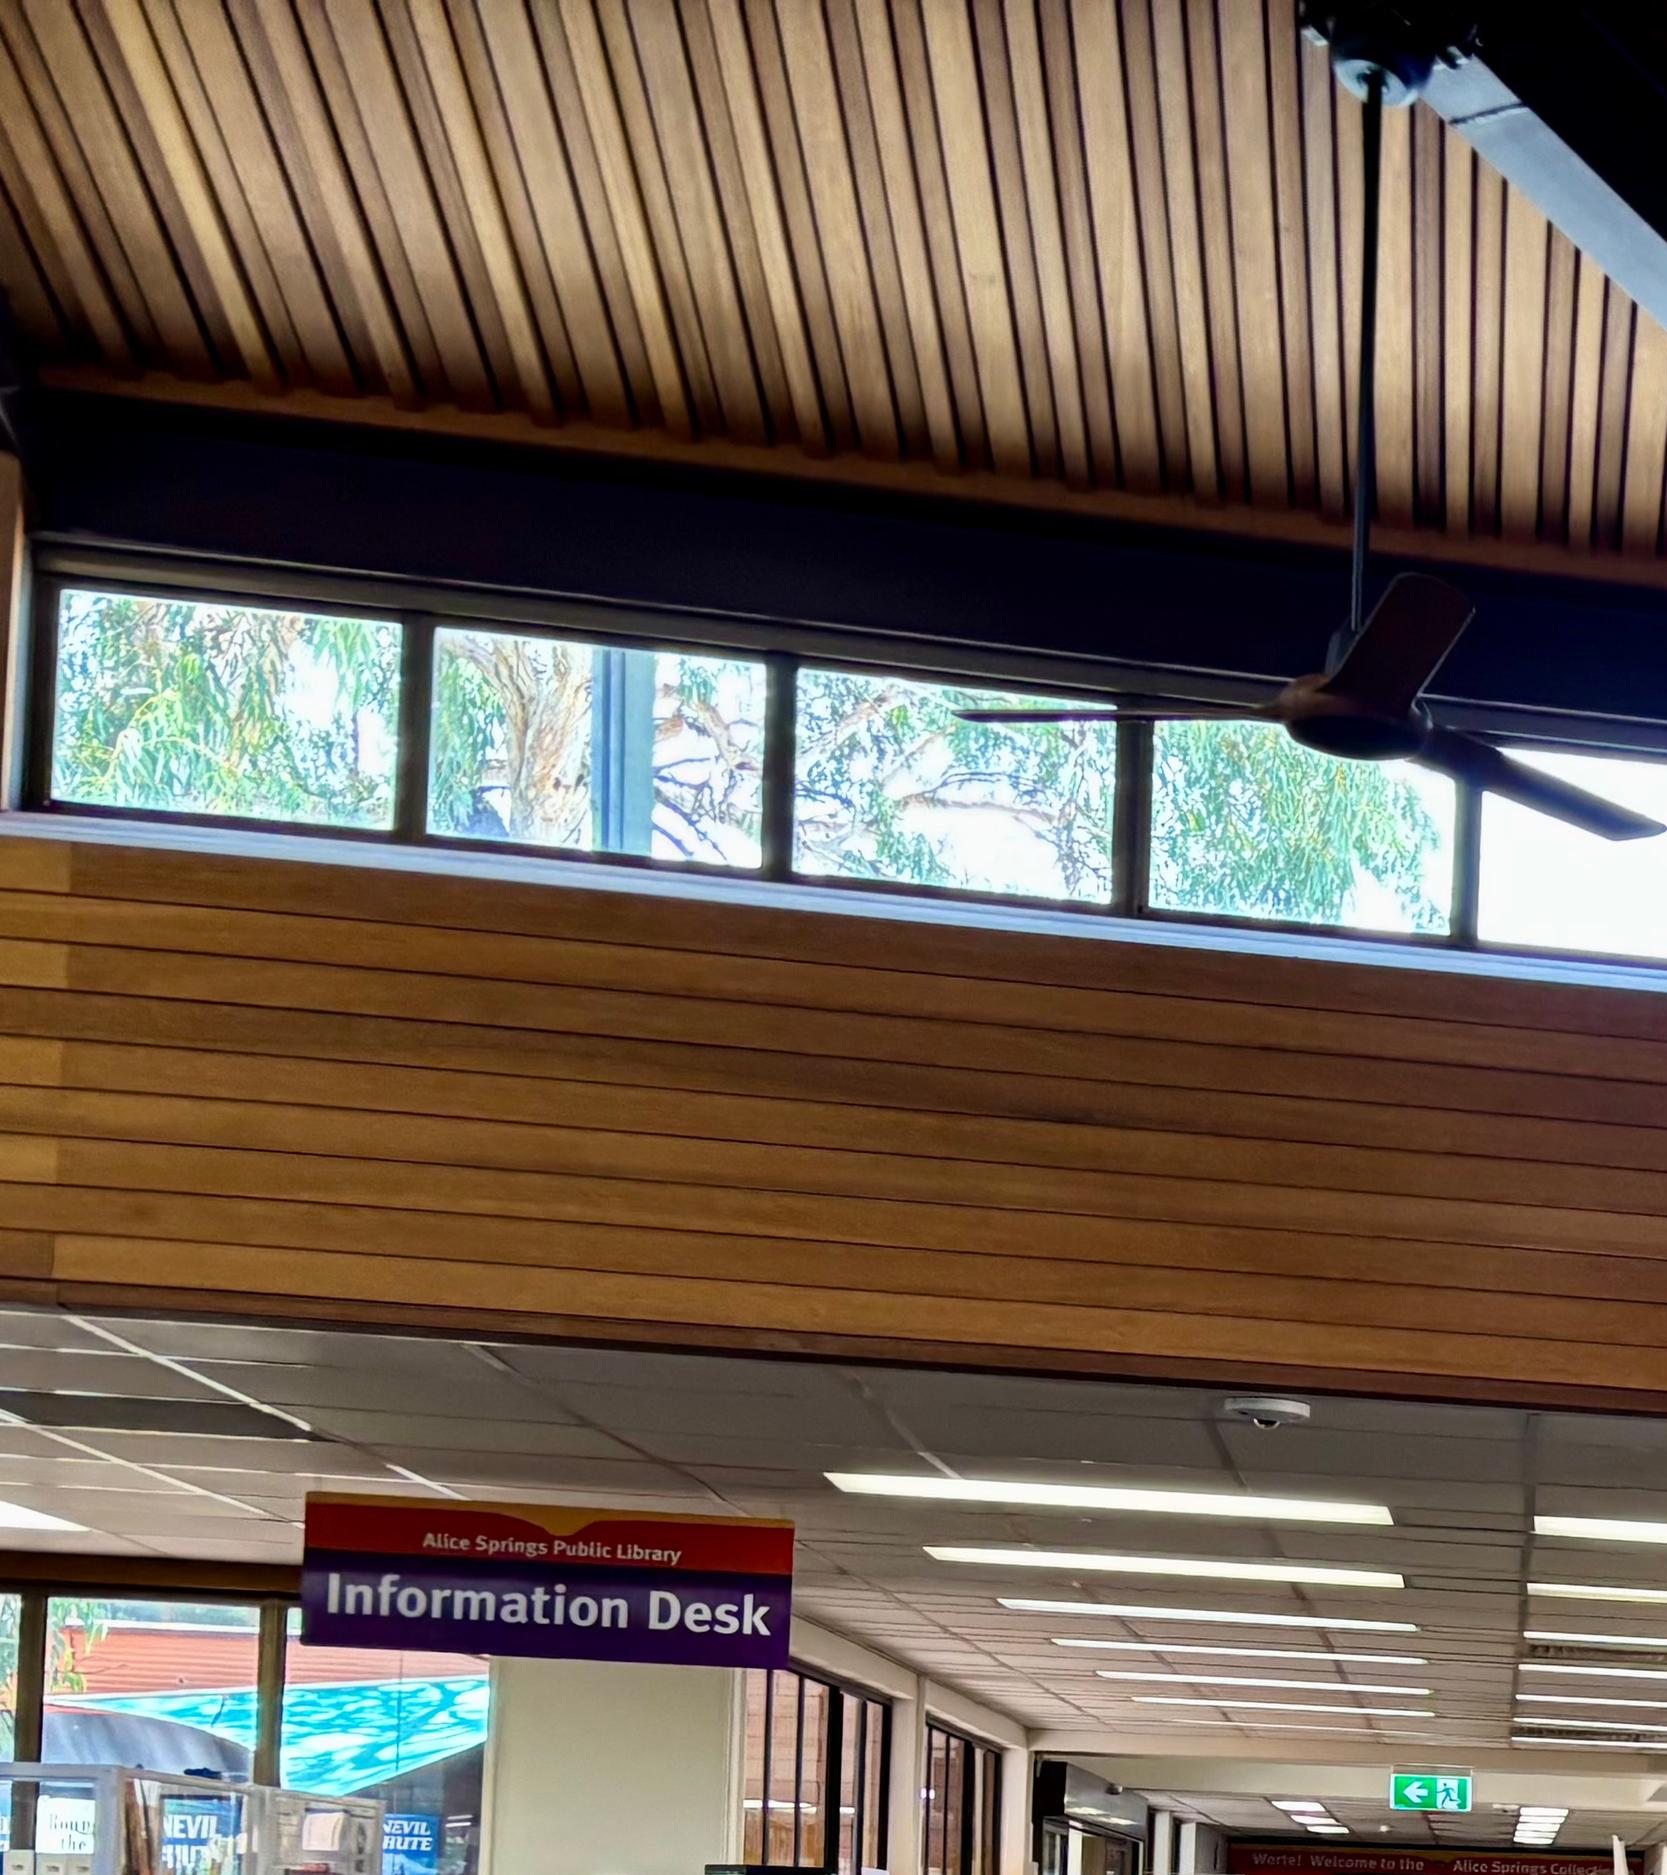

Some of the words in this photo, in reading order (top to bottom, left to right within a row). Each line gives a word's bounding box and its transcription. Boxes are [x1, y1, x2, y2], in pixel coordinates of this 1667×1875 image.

[422, 1533, 470, 1551] Alice
[475, 1535, 549, 1557] Springs
[553, 1540, 612, 1559] Public
[616, 1544, 682, 1566] Library
[326, 1572, 629, 1629] Information
[648, 1589, 771, 1636] Desk
[384, 1819, 432, 1835] NEVIL
[382, 1836, 433, 1851] HUTE
[1310, 1855, 1377, 1870] Welcome
[1380, 1858, 1395, 1871] to
[1399, 1855, 1425, 1872] the
[1453, 1858, 1488, 1874] Alice
